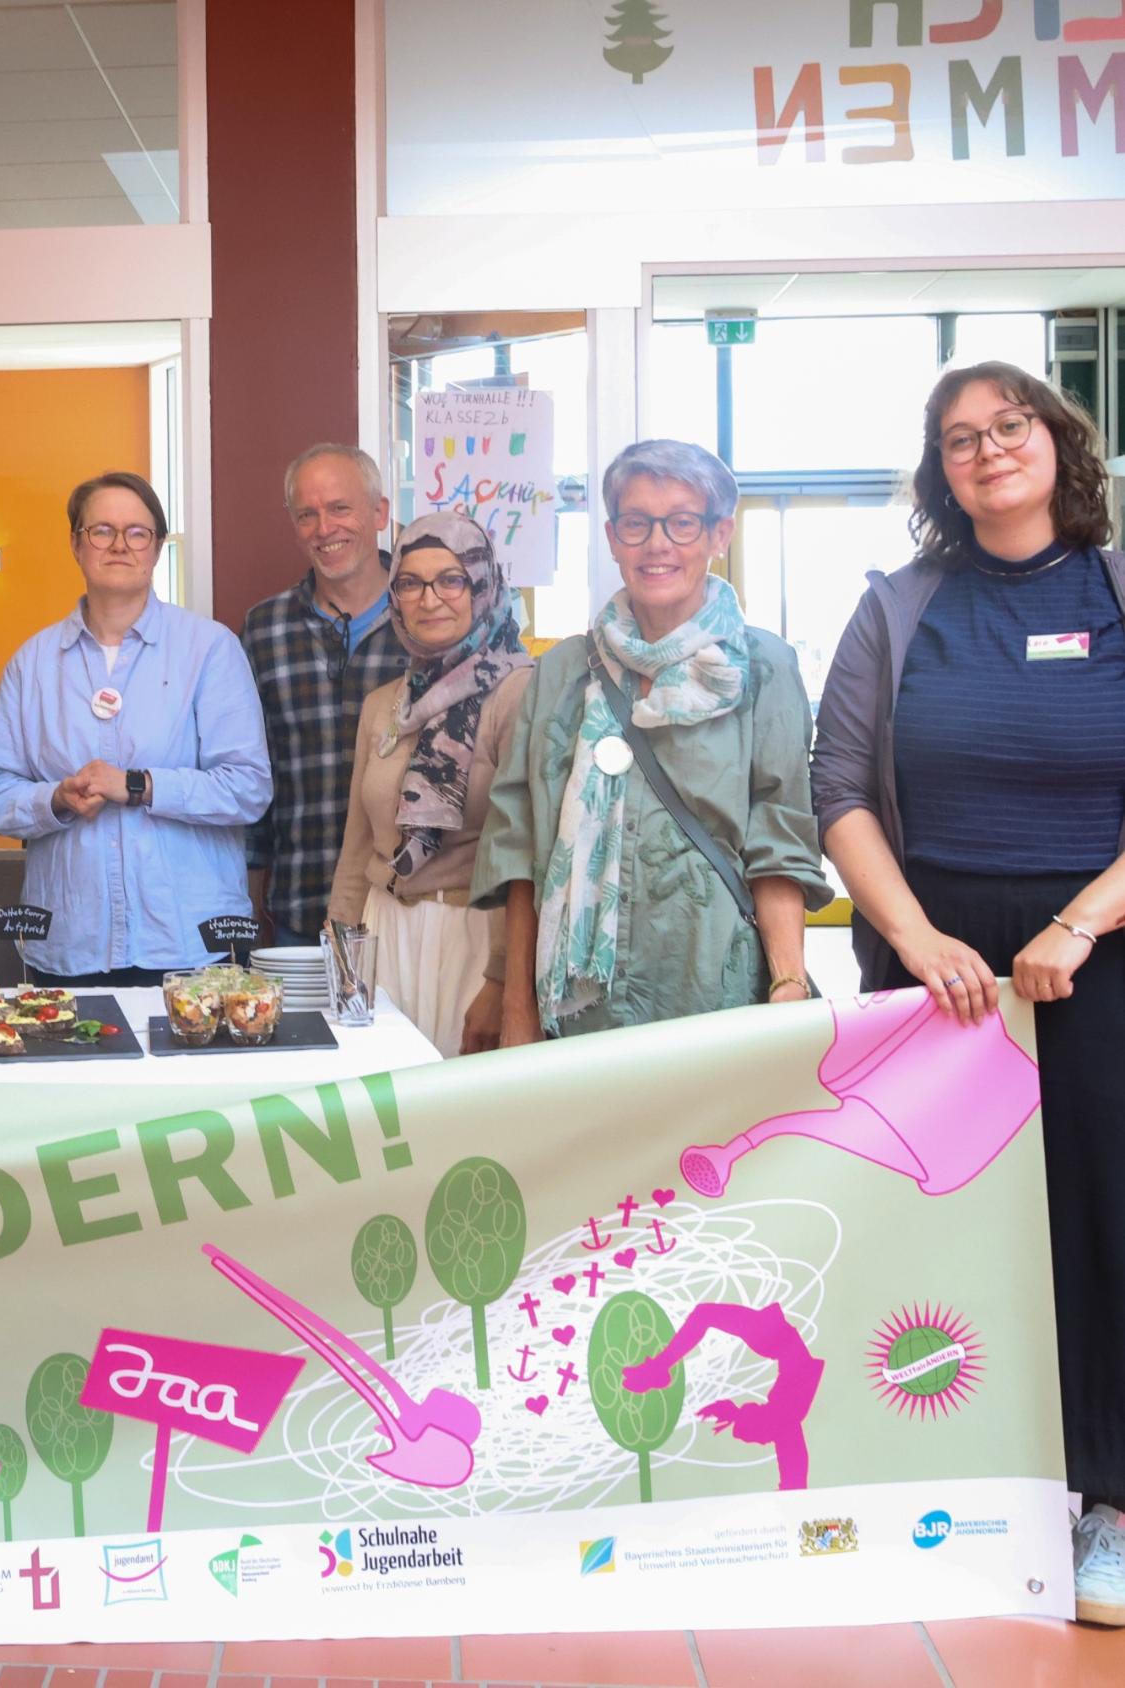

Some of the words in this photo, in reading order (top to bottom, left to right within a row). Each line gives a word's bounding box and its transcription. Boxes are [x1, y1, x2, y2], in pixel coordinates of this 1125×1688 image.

[455, 391, 511, 405] TURNHALLE
[358, 1524, 437, 1548] Schulnahe
[914, 1520, 950, 1538] BJR
[113, 1553, 154, 1567] jugendamt
[361, 1547, 464, 1575] Jugendarbeit
